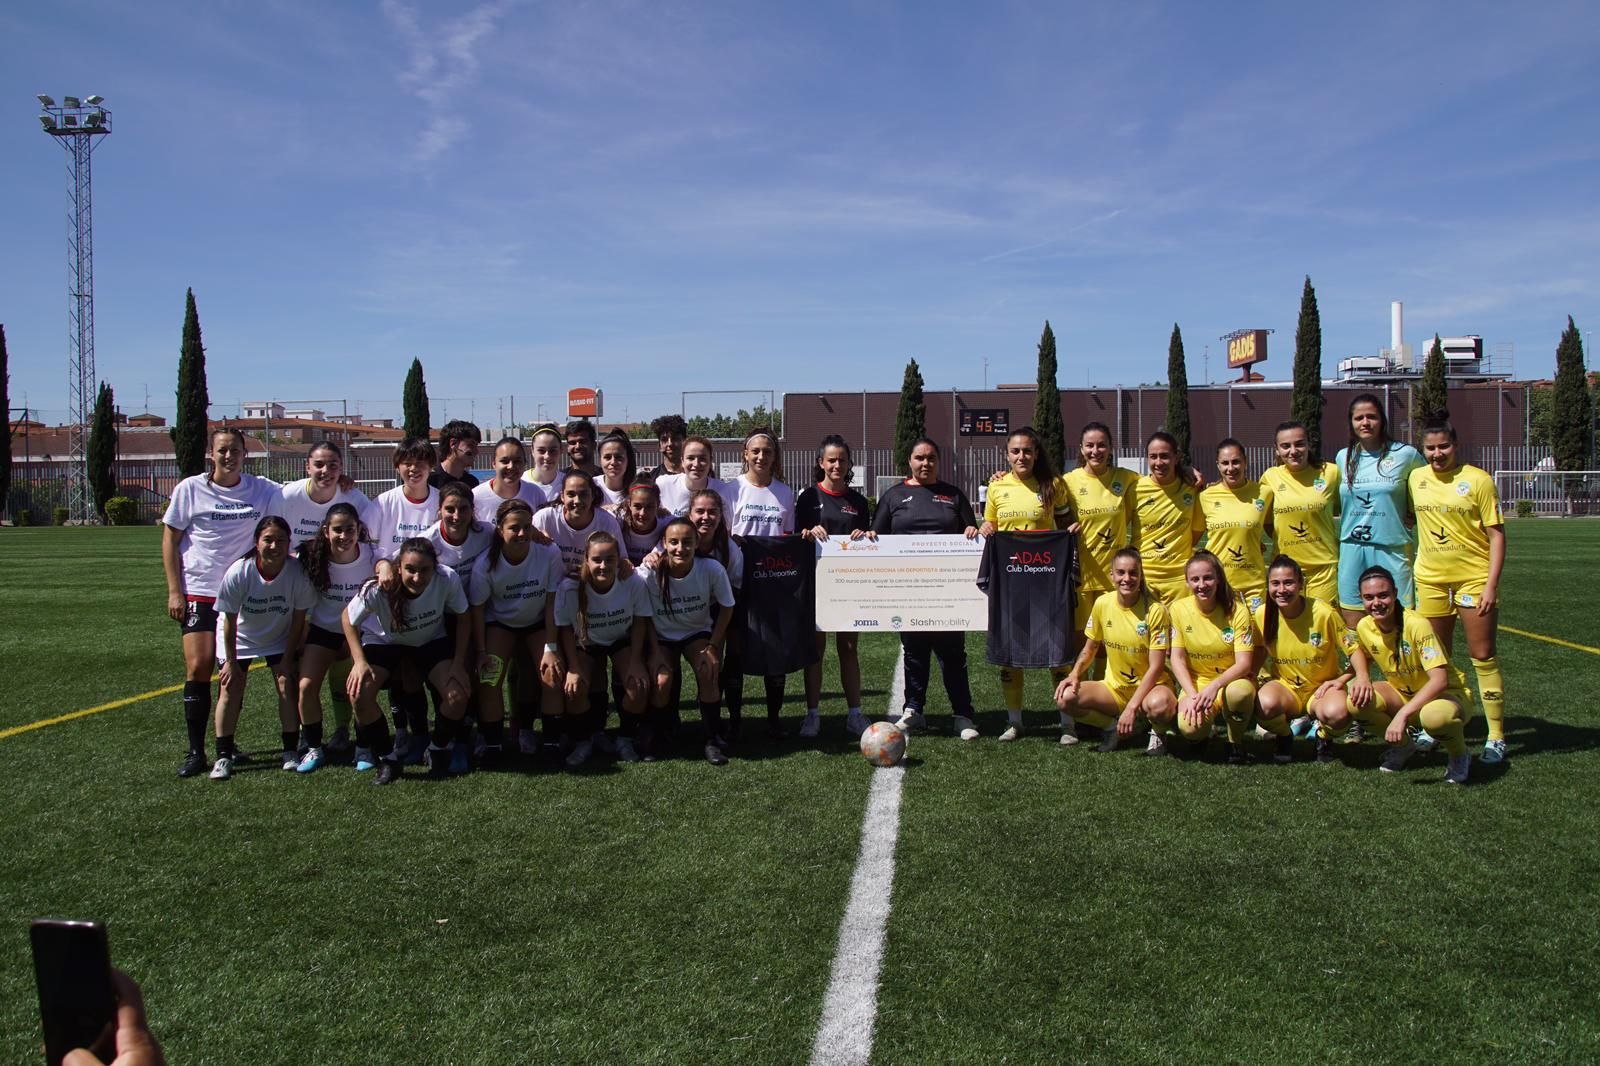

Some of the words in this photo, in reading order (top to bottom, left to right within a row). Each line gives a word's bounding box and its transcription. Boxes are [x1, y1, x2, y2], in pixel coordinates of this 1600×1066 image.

[1230, 333, 1255, 362] GADIS
[211, 512, 238, 521] Estamos
[1006, 564, 1022, 573] Club
[1023, 564, 1056, 575] Deportivo
[909, 616, 970, 628] Slashmobility
